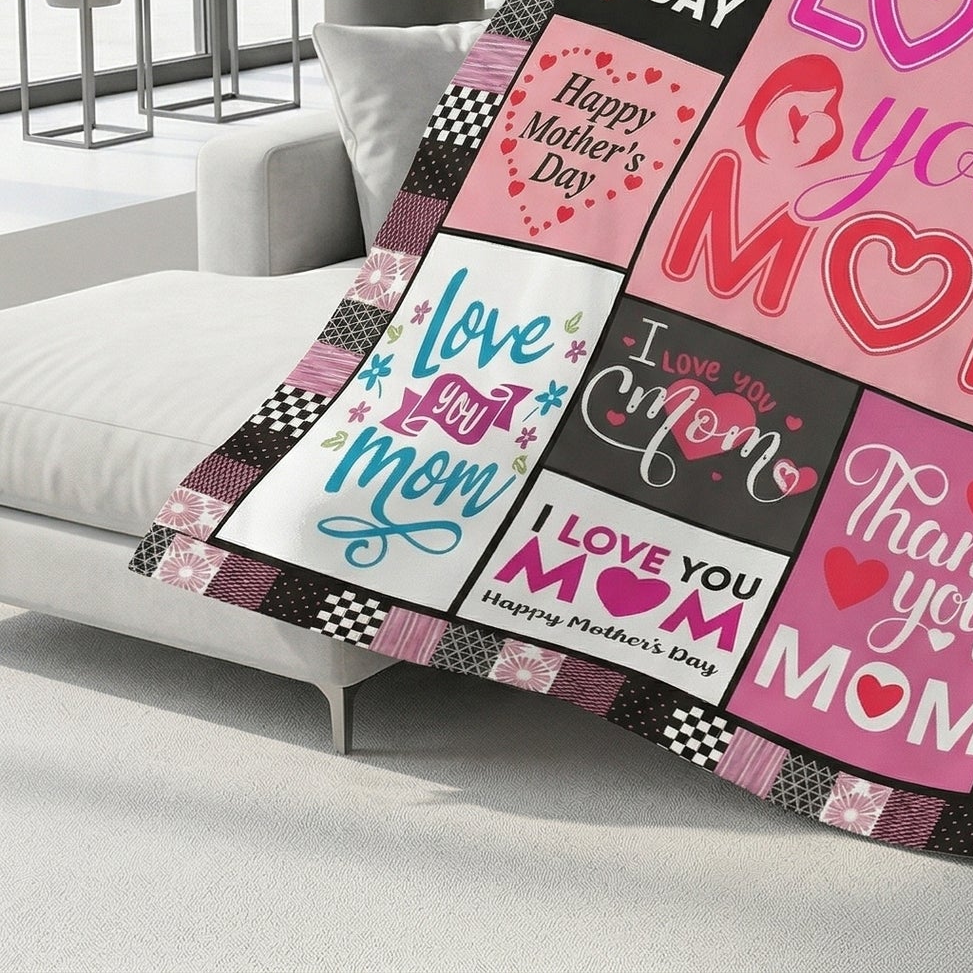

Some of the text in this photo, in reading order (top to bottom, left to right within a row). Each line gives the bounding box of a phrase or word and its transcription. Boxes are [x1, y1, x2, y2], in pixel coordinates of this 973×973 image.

[552, 72, 656, 135] Happy
[518, 111, 646, 172] Mother's
[528, 152, 596, 199] Day
[629, 317, 669, 367] I
[531, 503, 763, 600] I LOVE YOU
[481, 589, 719, 678] Happy Mother's Day
